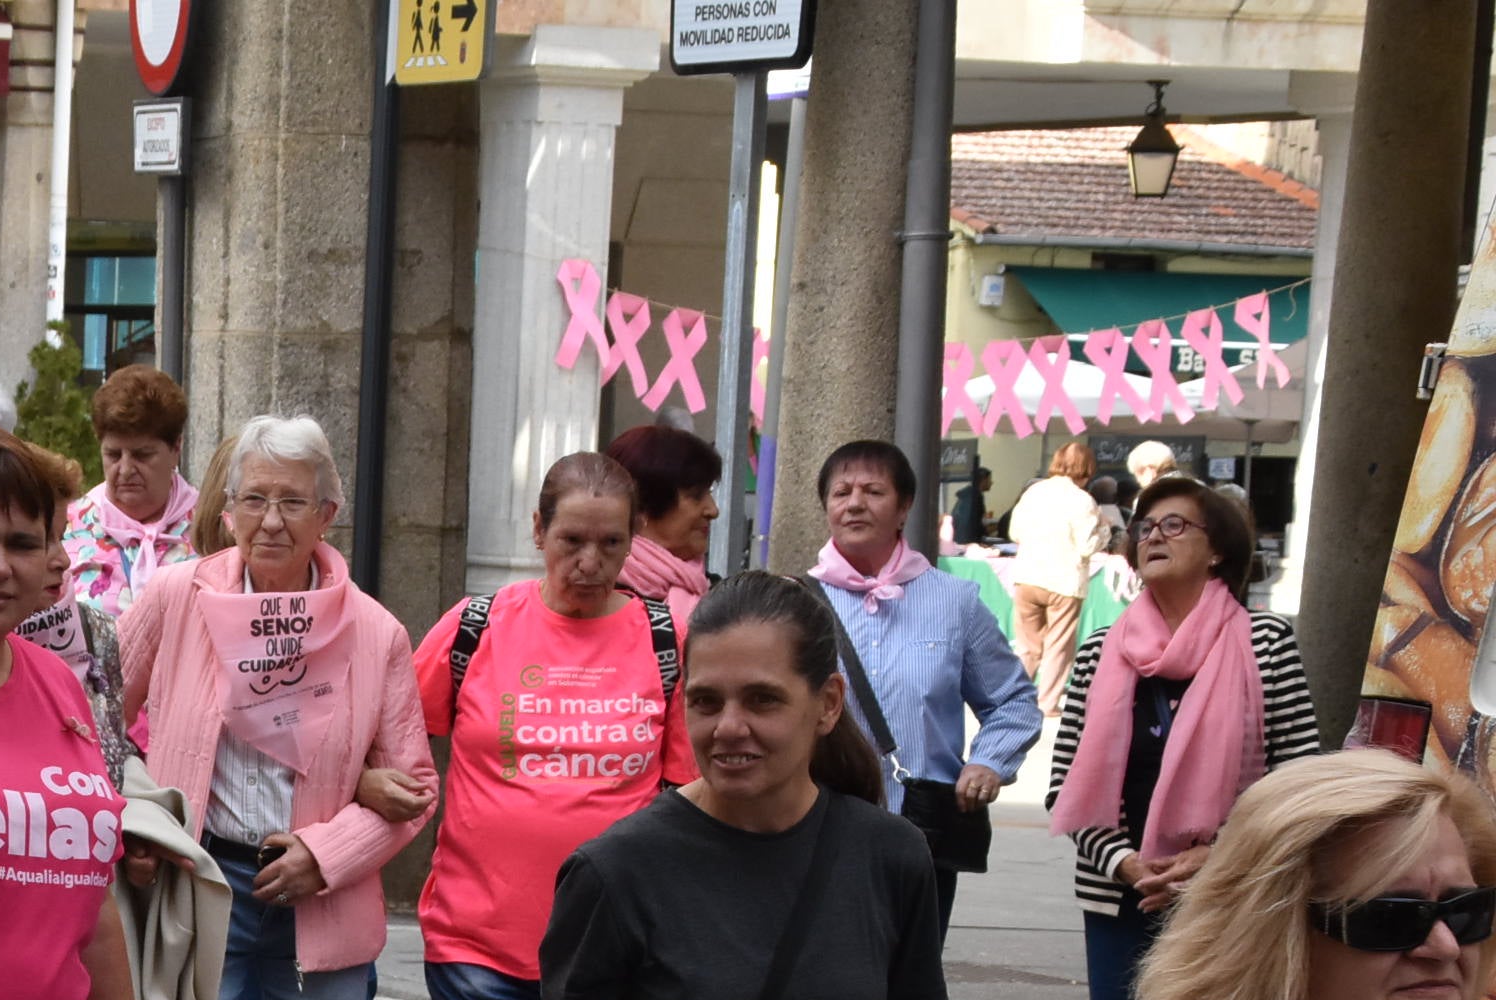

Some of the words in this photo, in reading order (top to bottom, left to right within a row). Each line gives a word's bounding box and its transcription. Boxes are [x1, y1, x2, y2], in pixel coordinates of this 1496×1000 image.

[694, 2, 751, 21] PERSONAS
[753, 0, 777, 17] CON
[679, 27, 735, 47] MOVILIDAD
[736, 23, 791, 42] REDUCIDA
[260, 597, 282, 616] QUE
[290, 596, 306, 615] NO
[250, 616, 313, 637] SENOS
[266, 636, 304, 657] OLVIDE
[518, 693, 552, 715] En
[559, 692, 661, 715] marcha
[499, 693, 517, 780] GUIJUELO
[516, 720, 628, 744] contra
[632, 717, 656, 743] el
[519, 746, 655, 778] cáncer
